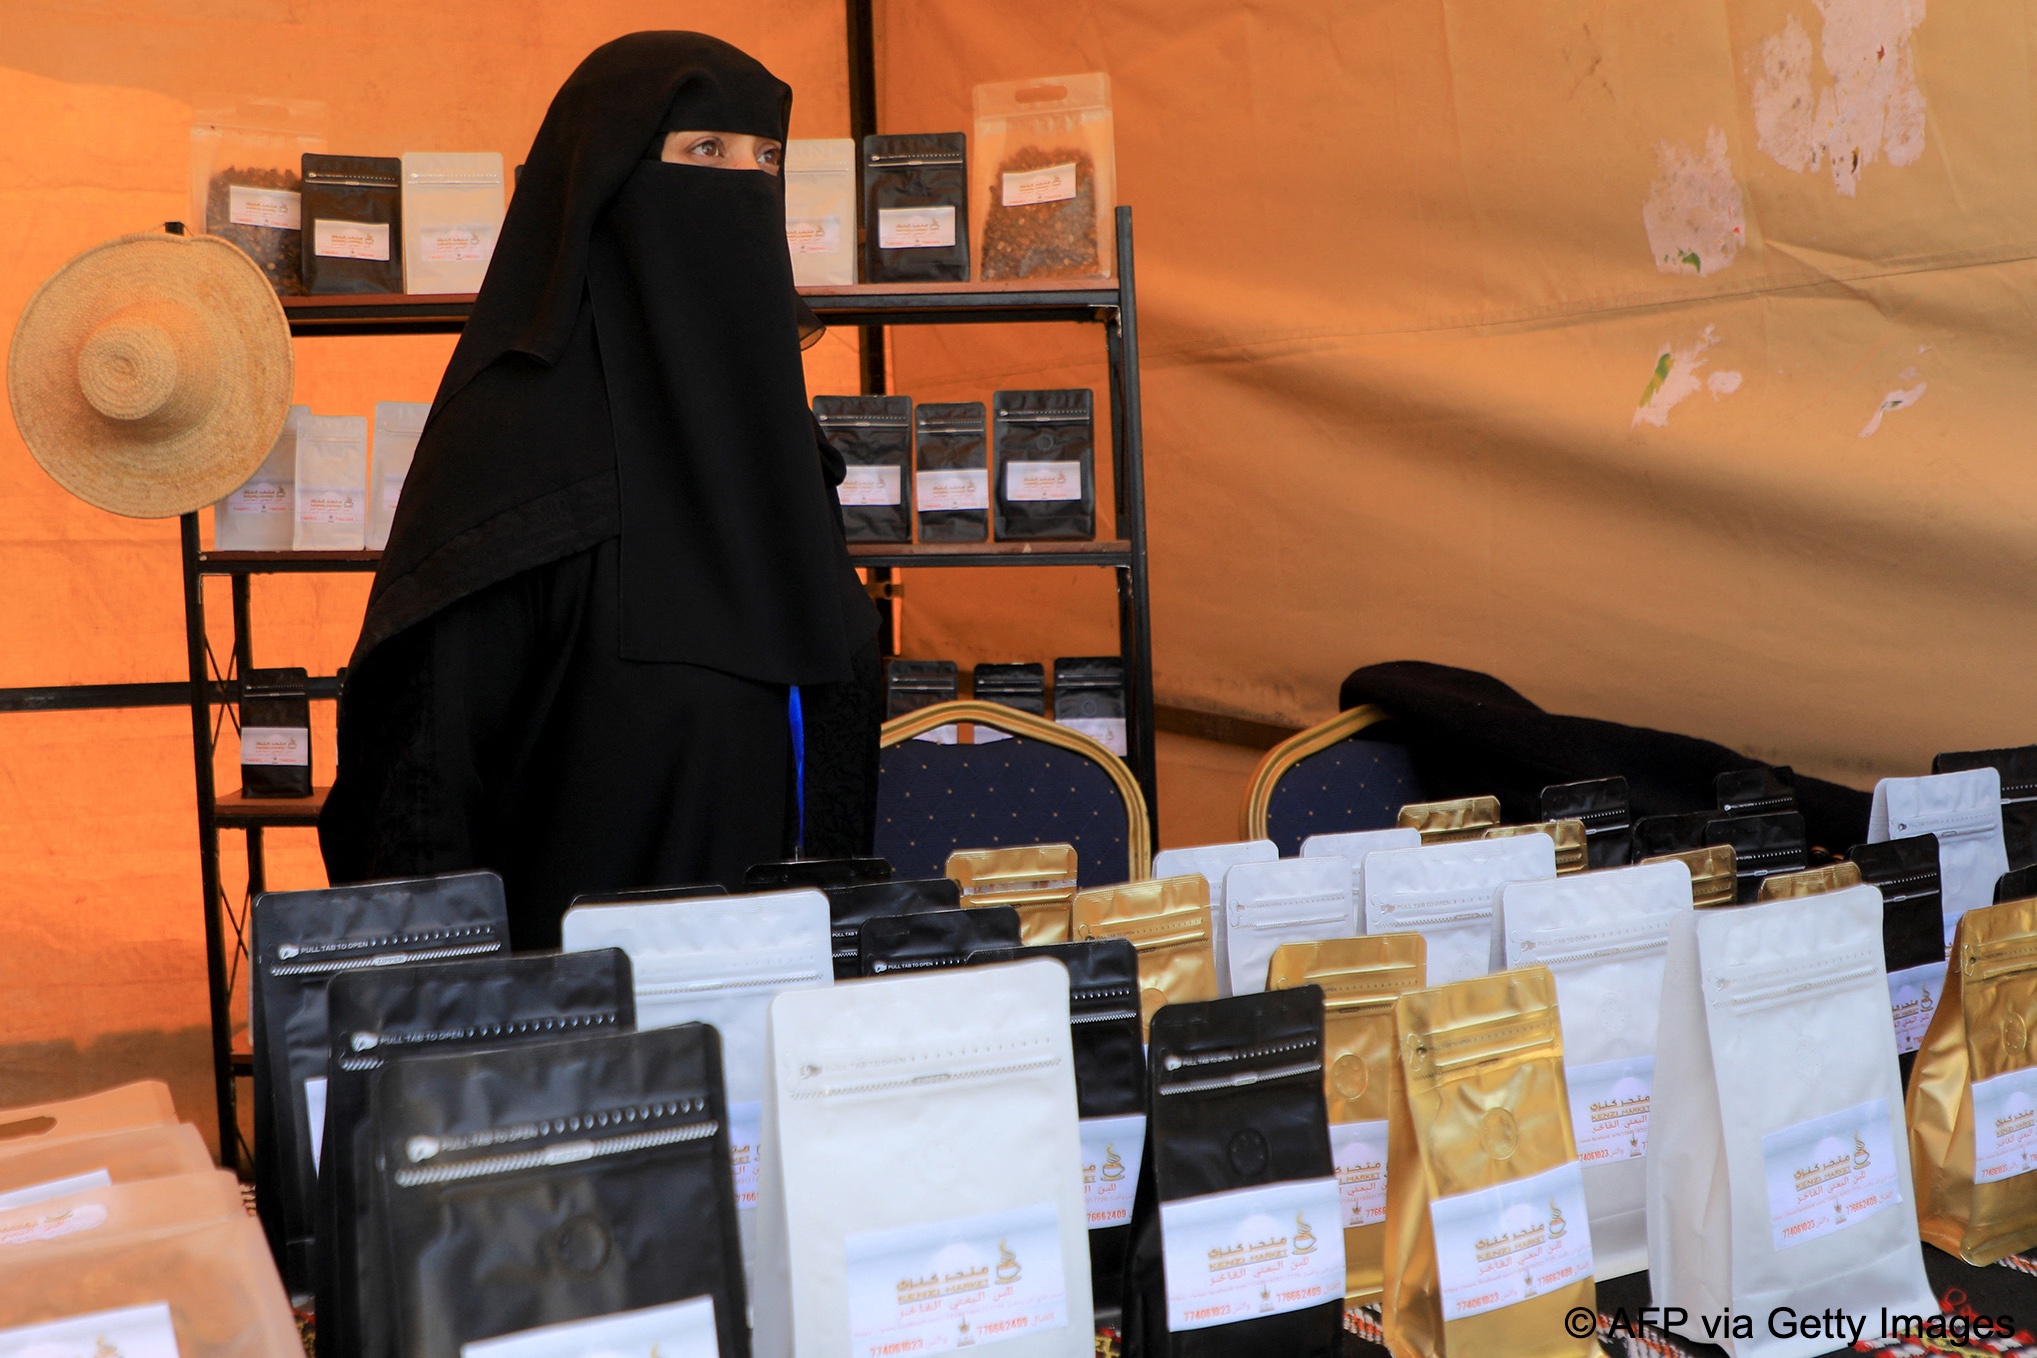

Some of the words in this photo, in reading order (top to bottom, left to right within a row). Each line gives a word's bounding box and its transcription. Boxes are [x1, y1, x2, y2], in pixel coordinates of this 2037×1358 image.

[347, 941, 369, 949] OPEN
[1209, 1258, 1246, 1271] KENZI
[1249, 1249, 1287, 1262] MARKET
[1477, 1246, 1511, 1261] KENZI
[1276, 1285, 1322, 1304] 776662409
[1183, 1304, 1232, 1323] 774061023
